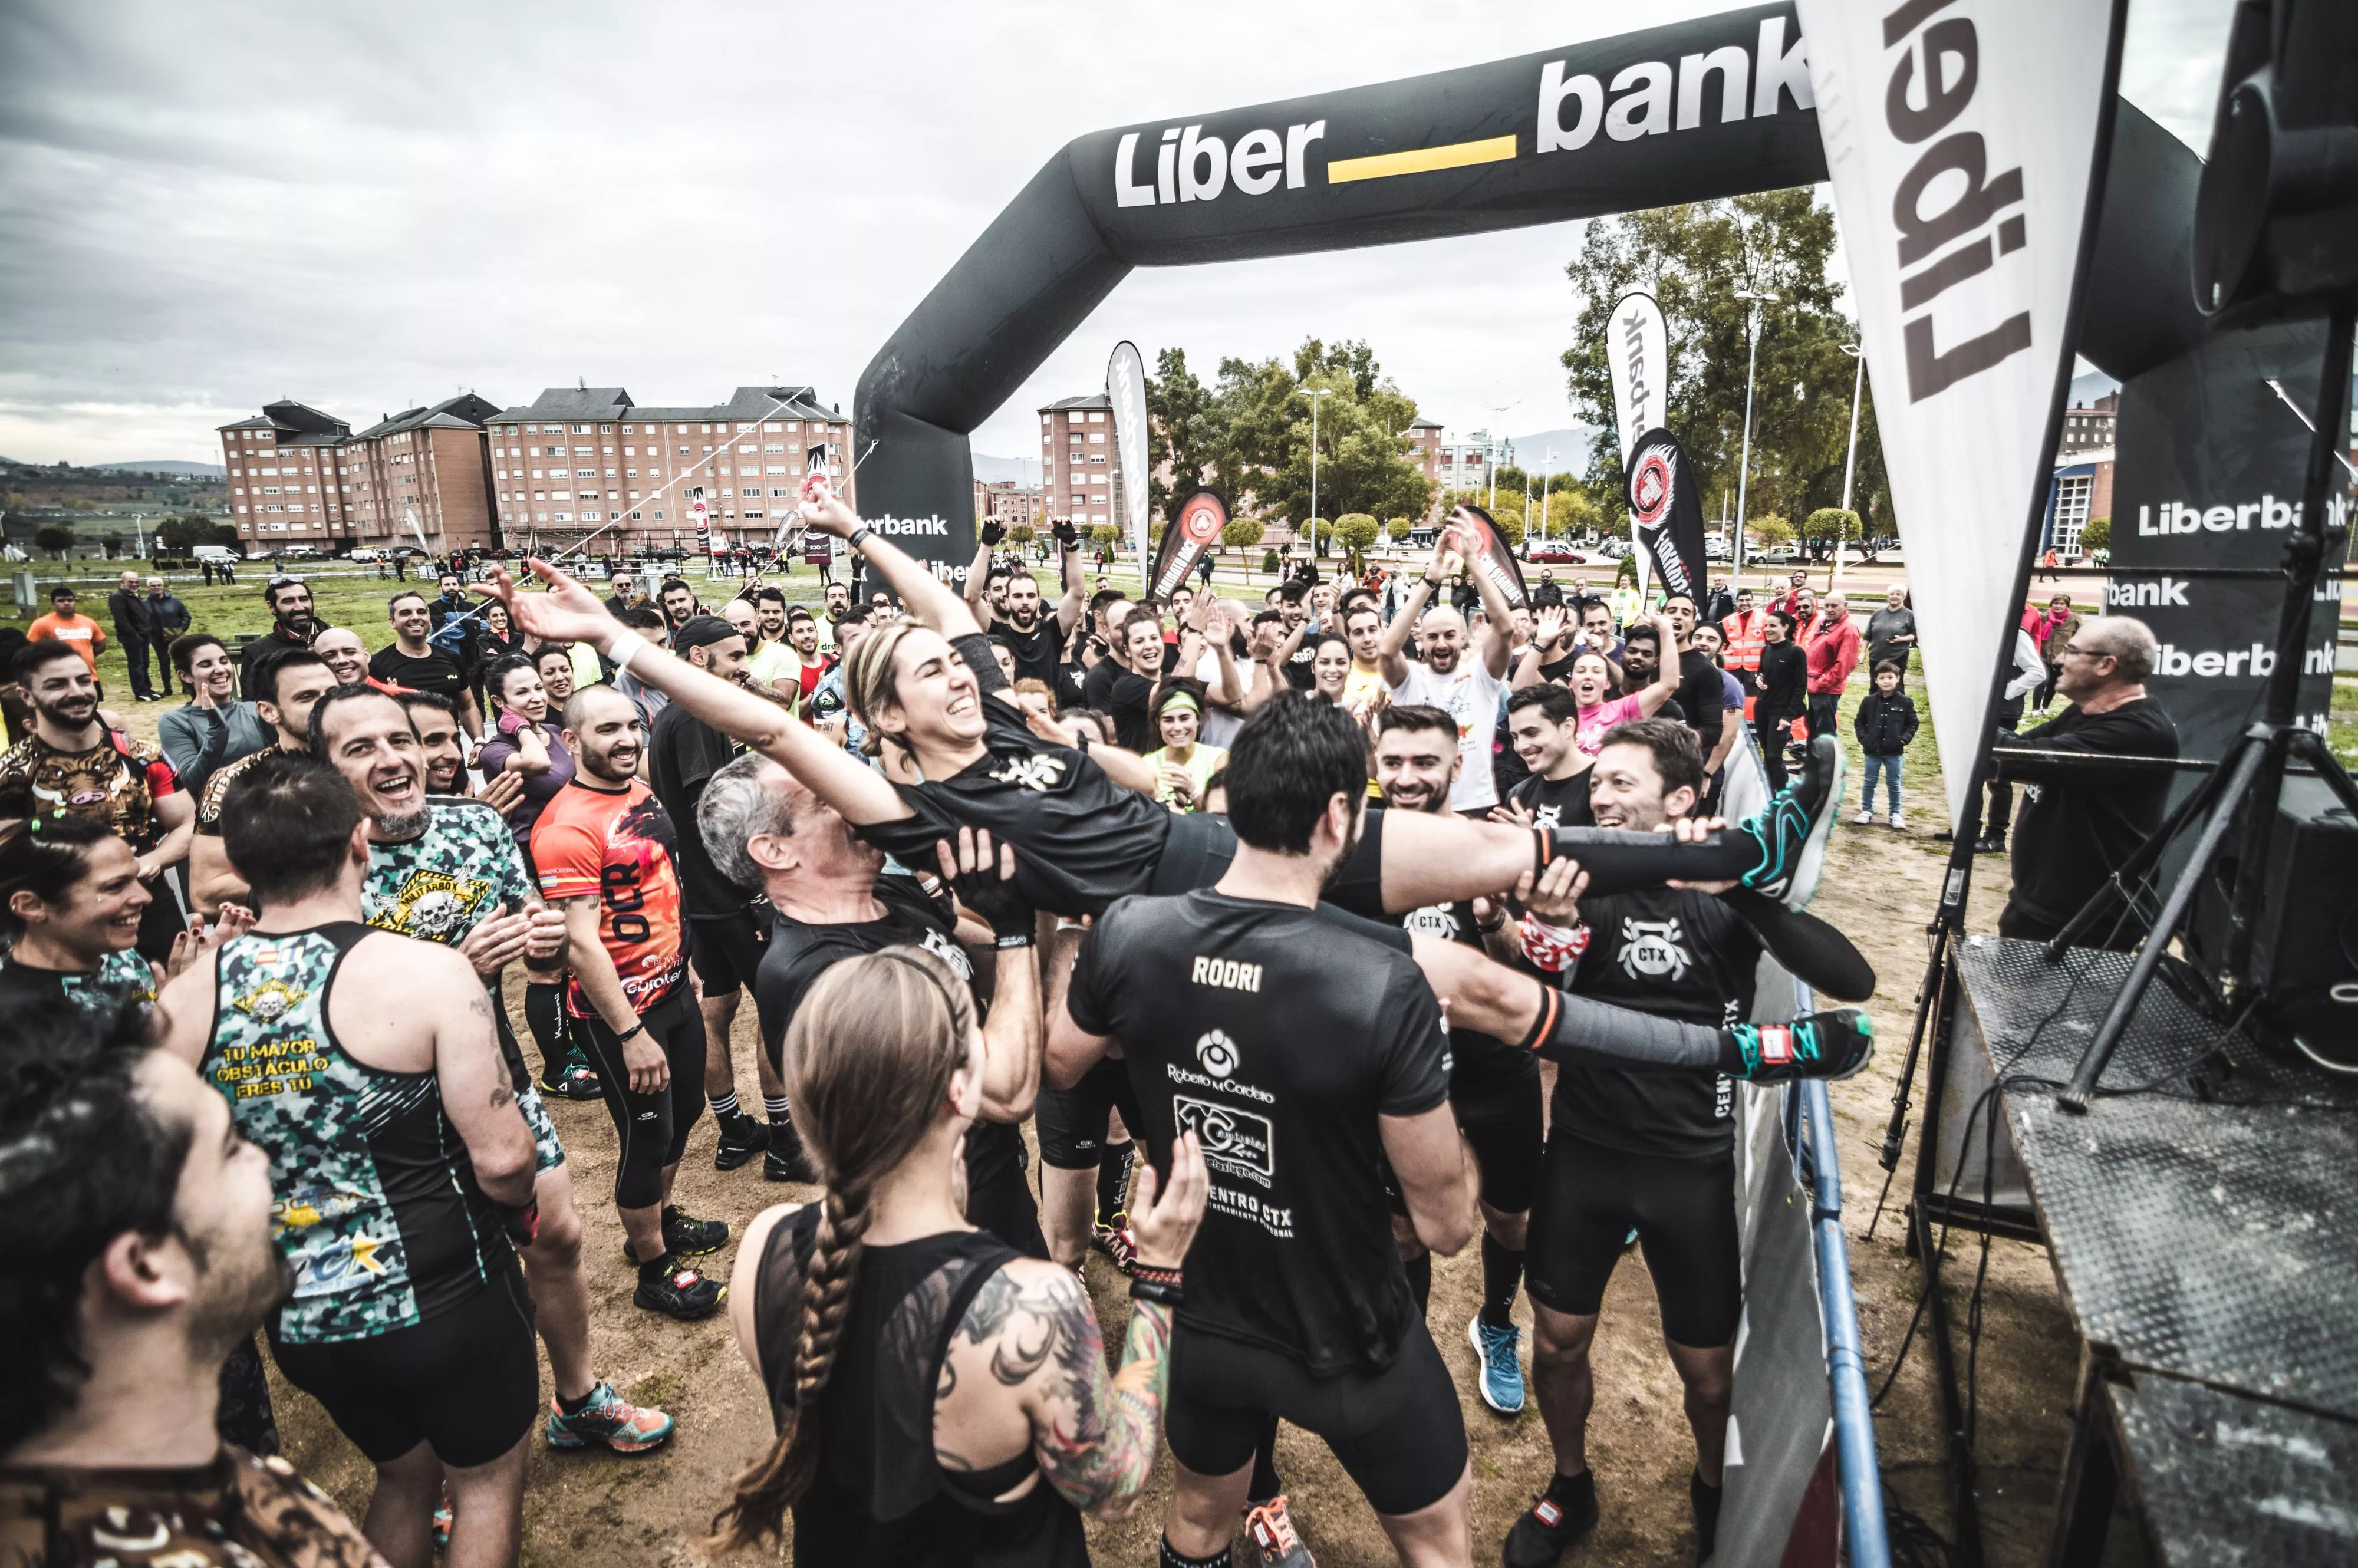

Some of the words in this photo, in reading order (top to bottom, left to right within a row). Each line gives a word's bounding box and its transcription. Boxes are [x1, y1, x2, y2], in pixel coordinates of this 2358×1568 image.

[1115, 120, 1326, 207] Liber
[1537, 16, 1816, 153] bank
[2139, 493, 2346, 536] Liberbnk
[601, 859, 650, 943] OCR
[1420, 916, 1441, 928] CTX
[1639, 947, 1667, 963] CTX
[1192, 956, 1263, 993] RODRI
[223, 1046, 245, 1062] TU
[250, 1039, 316, 1060] MAYOR
[216, 1057, 328, 1082] OBSTÁCULO
[236, 1080, 284, 1099] ERES
[287, 1073, 312, 1092] TÚ
[1209, 1185, 1259, 1213] ENTRO
[1263, 1204, 1292, 1227] CTX
[1209, 1203, 1257, 1222] TRENAMIENTO
